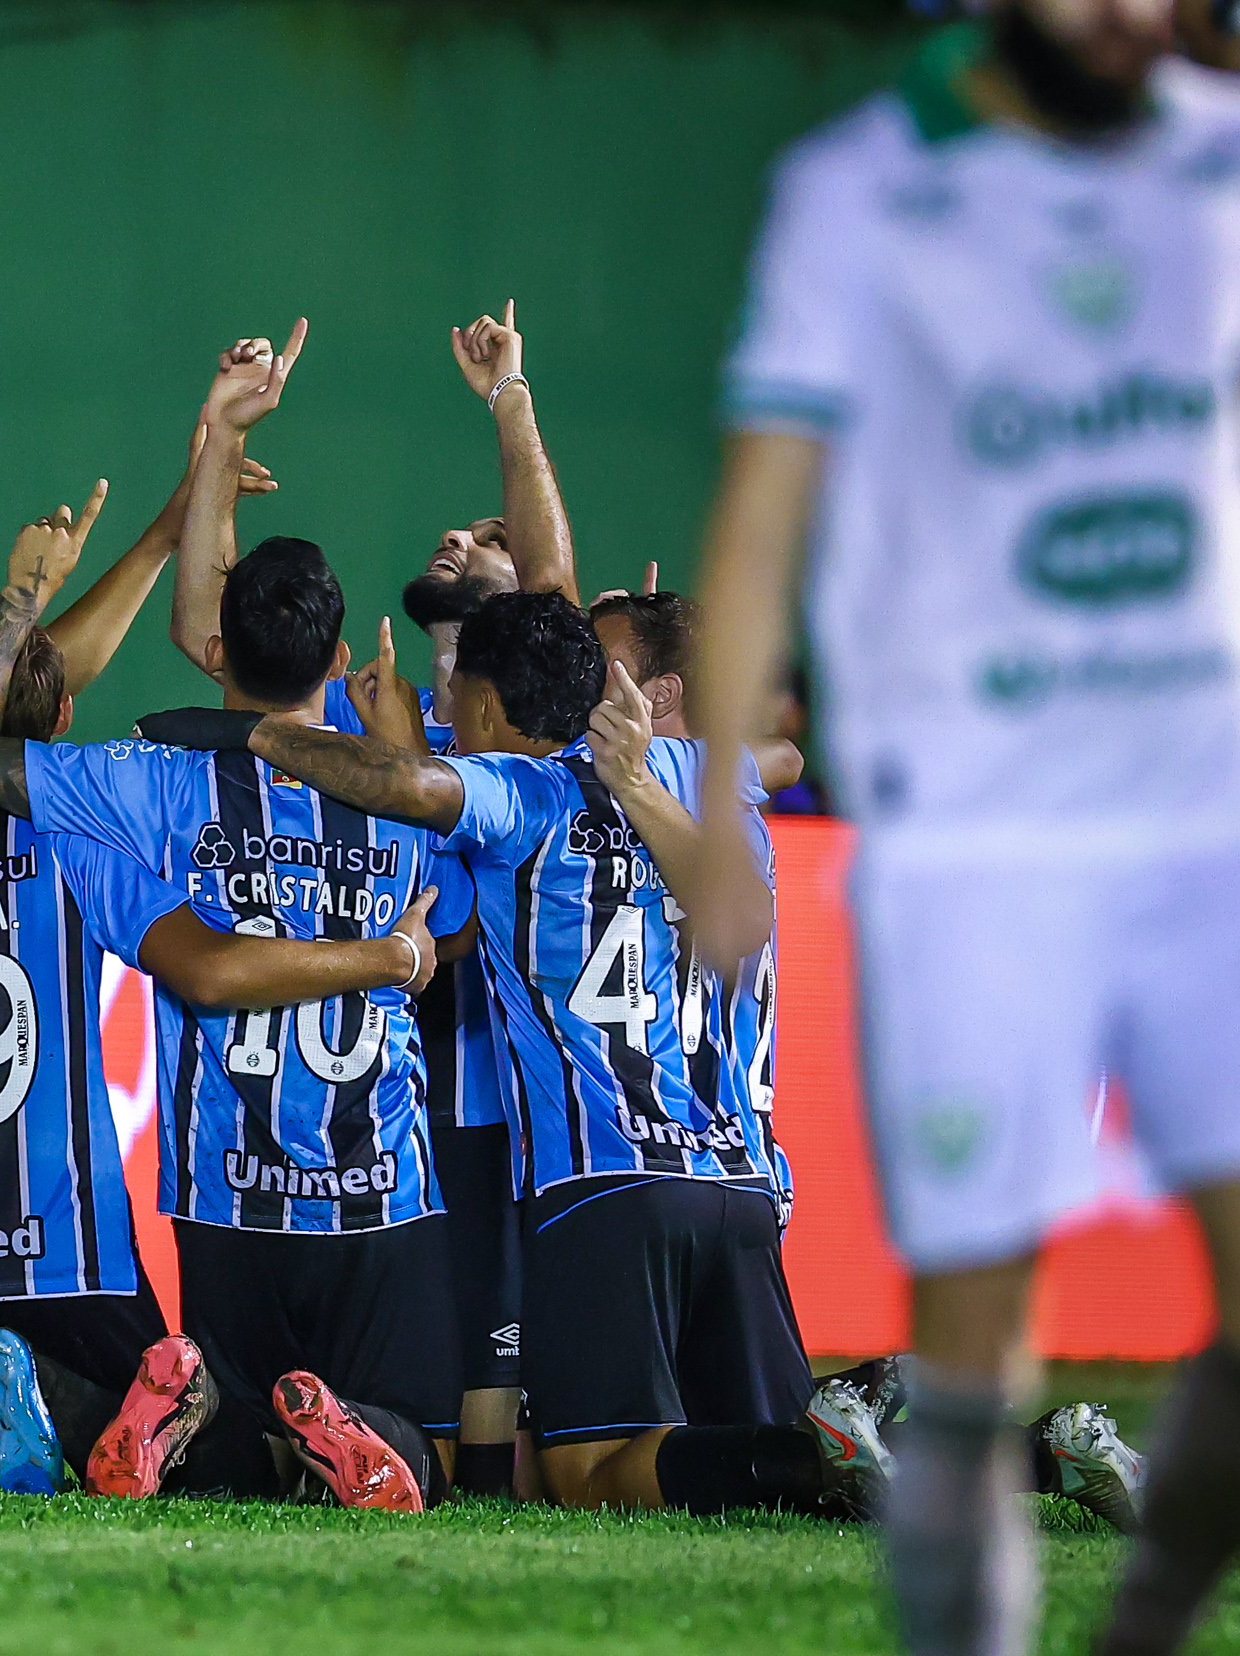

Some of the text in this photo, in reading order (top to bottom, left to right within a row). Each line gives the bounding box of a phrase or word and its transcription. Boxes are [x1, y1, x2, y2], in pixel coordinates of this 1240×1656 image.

[243, 828, 396, 875] banrisul
[187, 872, 395, 926] F. CRISTALDO
[627, 943, 639, 1009] MARQUESPAN
[17, 1000, 28, 1066] MARQUESPAN
[227, 1152, 396, 1197] Unimed
